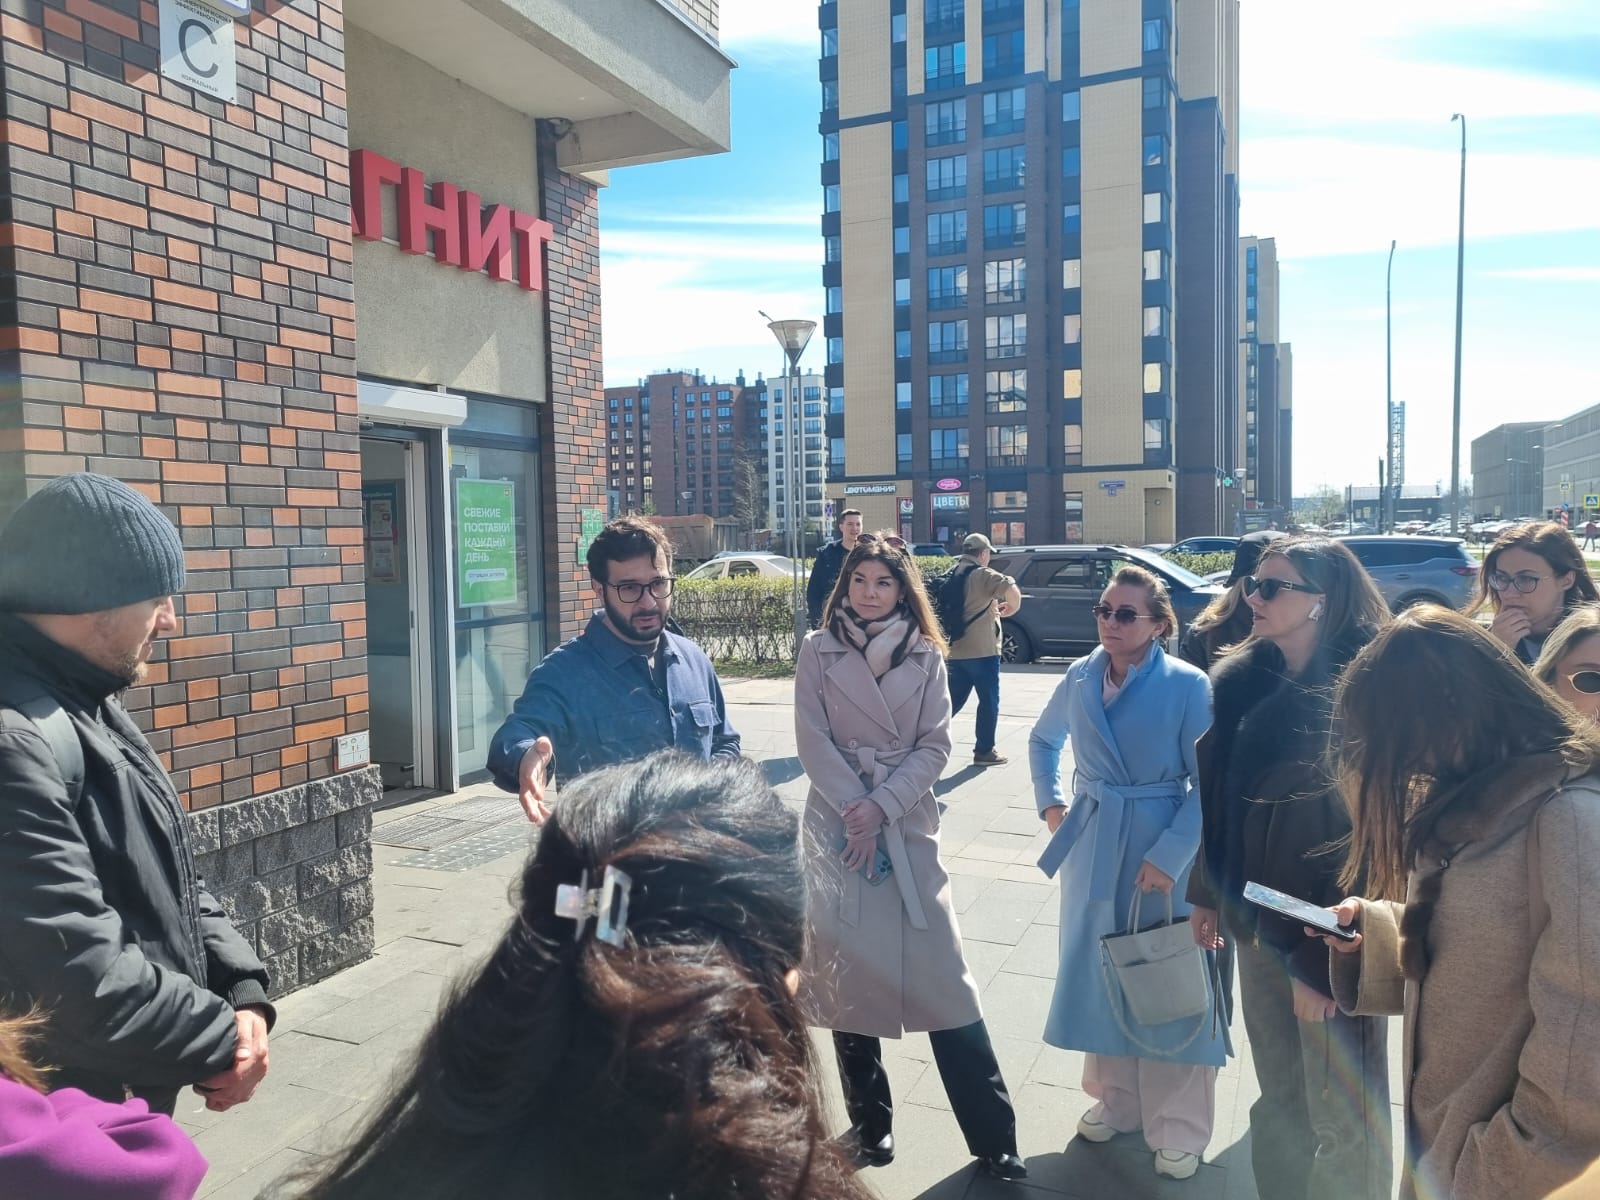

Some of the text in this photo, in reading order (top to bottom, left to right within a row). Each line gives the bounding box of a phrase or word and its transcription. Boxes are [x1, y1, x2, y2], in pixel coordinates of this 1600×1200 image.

[350, 149, 553, 291] ГНИТ
[933, 496, 969, 508] ЦВЕТЫ
[464, 507, 501, 518] СВЕЖИЕ
[464, 522, 510, 533] ПОСТАВКИ
[464, 534, 506, 548] КАЖДЫЙ
[464, 552, 490, 564] ДЕНЬ
